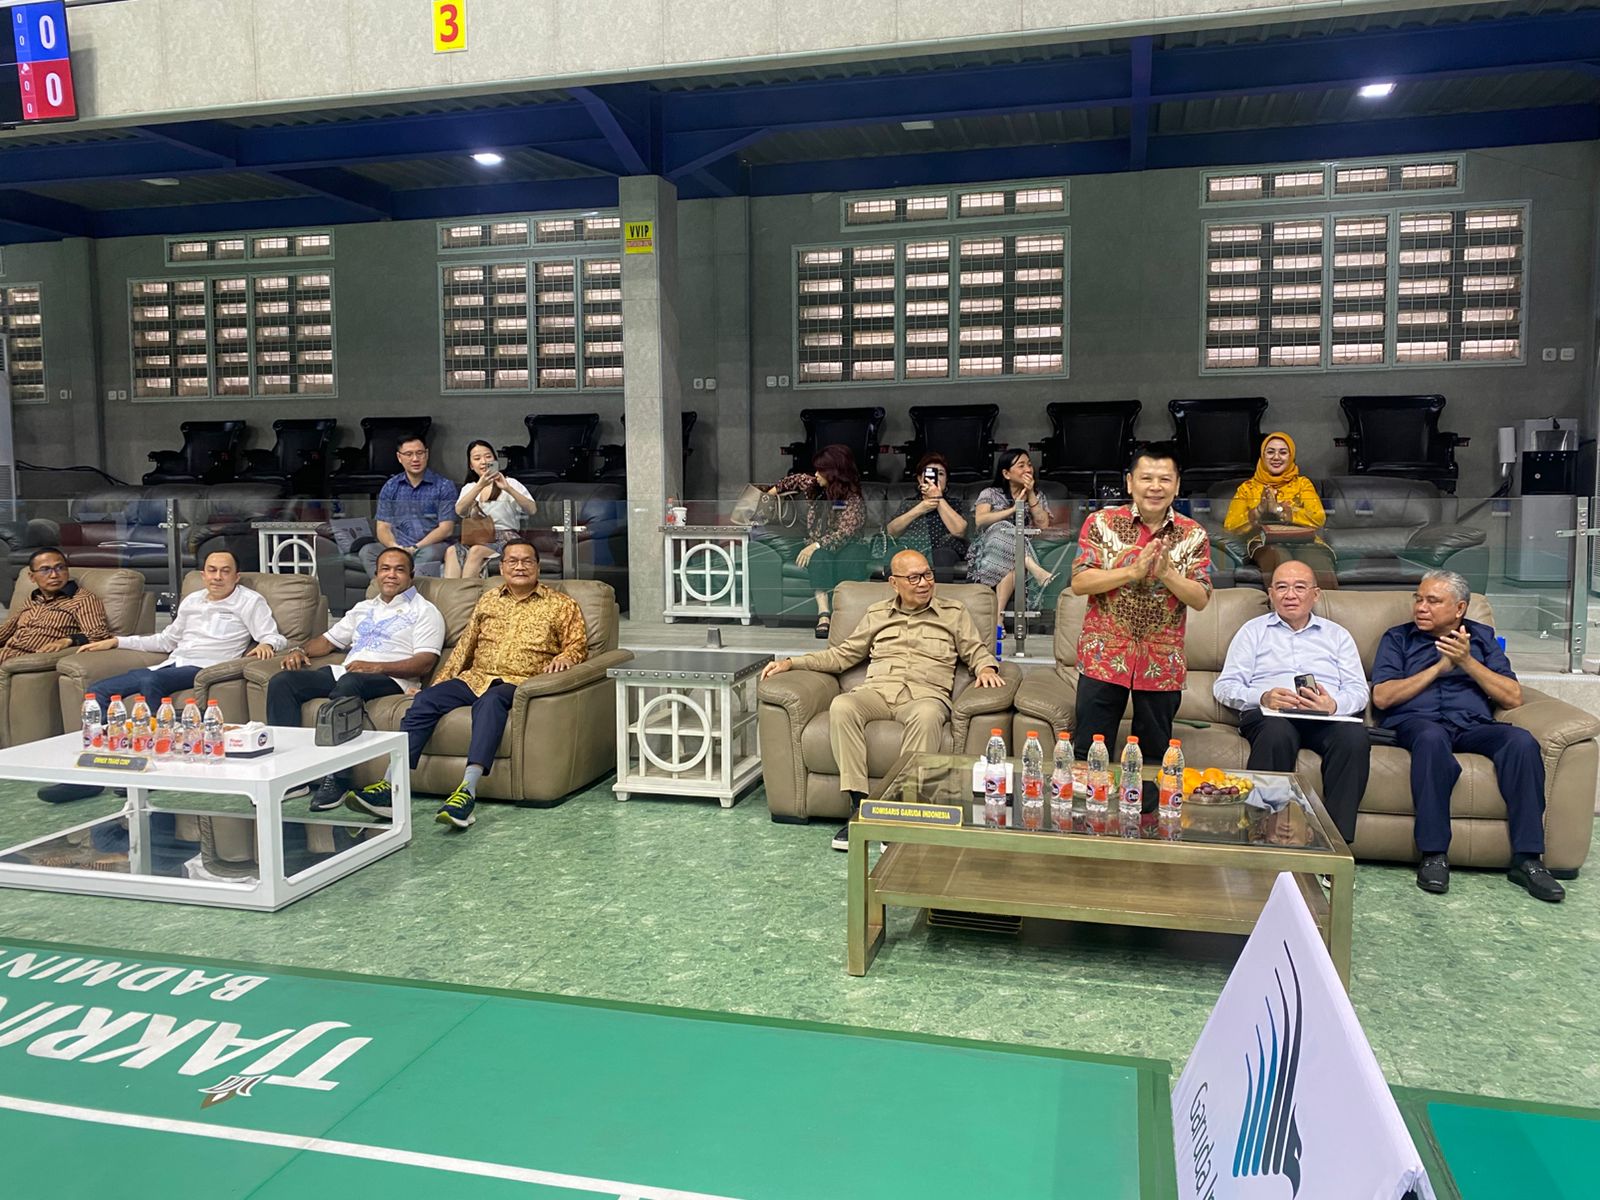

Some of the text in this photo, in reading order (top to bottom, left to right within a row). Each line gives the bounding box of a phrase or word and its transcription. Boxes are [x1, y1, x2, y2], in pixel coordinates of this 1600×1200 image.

[16, 13, 23, 24] 0
[440, 4, 459, 43] 3
[39, 15, 55, 49] 0
[19, 35, 25, 46] 0
[24, 80, 30, 91] 0
[46, 72, 63, 107] 0
[27, 103, 33, 113] 0
[629, 224, 650, 238] VVIP
[872, 806, 951, 820] KOMISARIS GARUDA INDONESIA
[0, 951, 270, 1001] BADMIN
[1190, 1082, 1214, 1195] Garuda
